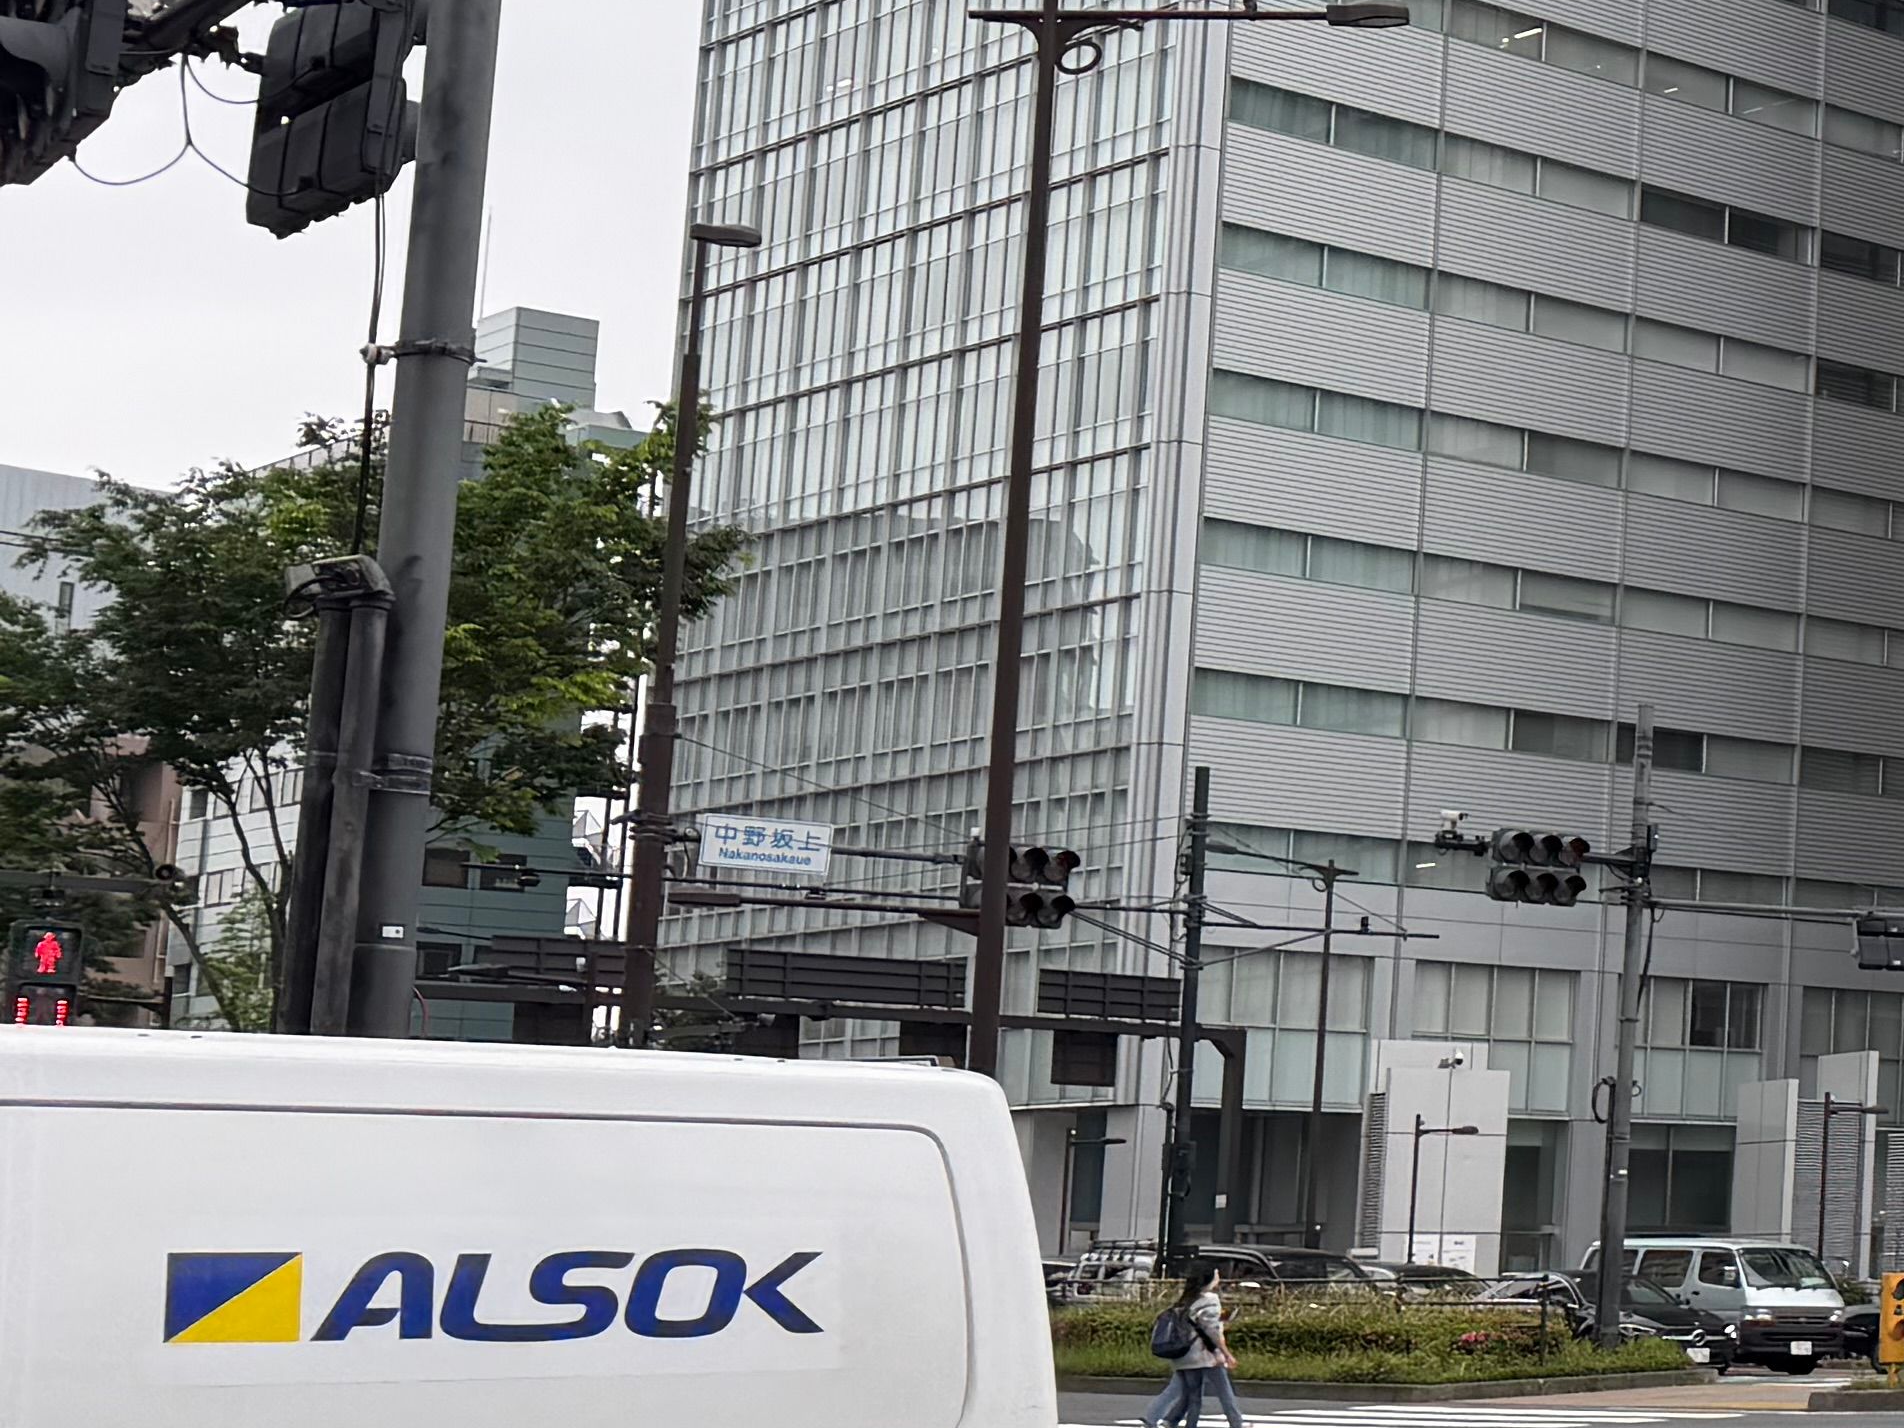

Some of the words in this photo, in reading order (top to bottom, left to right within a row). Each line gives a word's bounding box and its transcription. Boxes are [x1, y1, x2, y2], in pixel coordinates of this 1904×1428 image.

[715, 823, 821, 852] 中野坂上
[719, 847, 812, 866] Nakanosakaue
[310, 1248, 824, 1342] ALSOK
